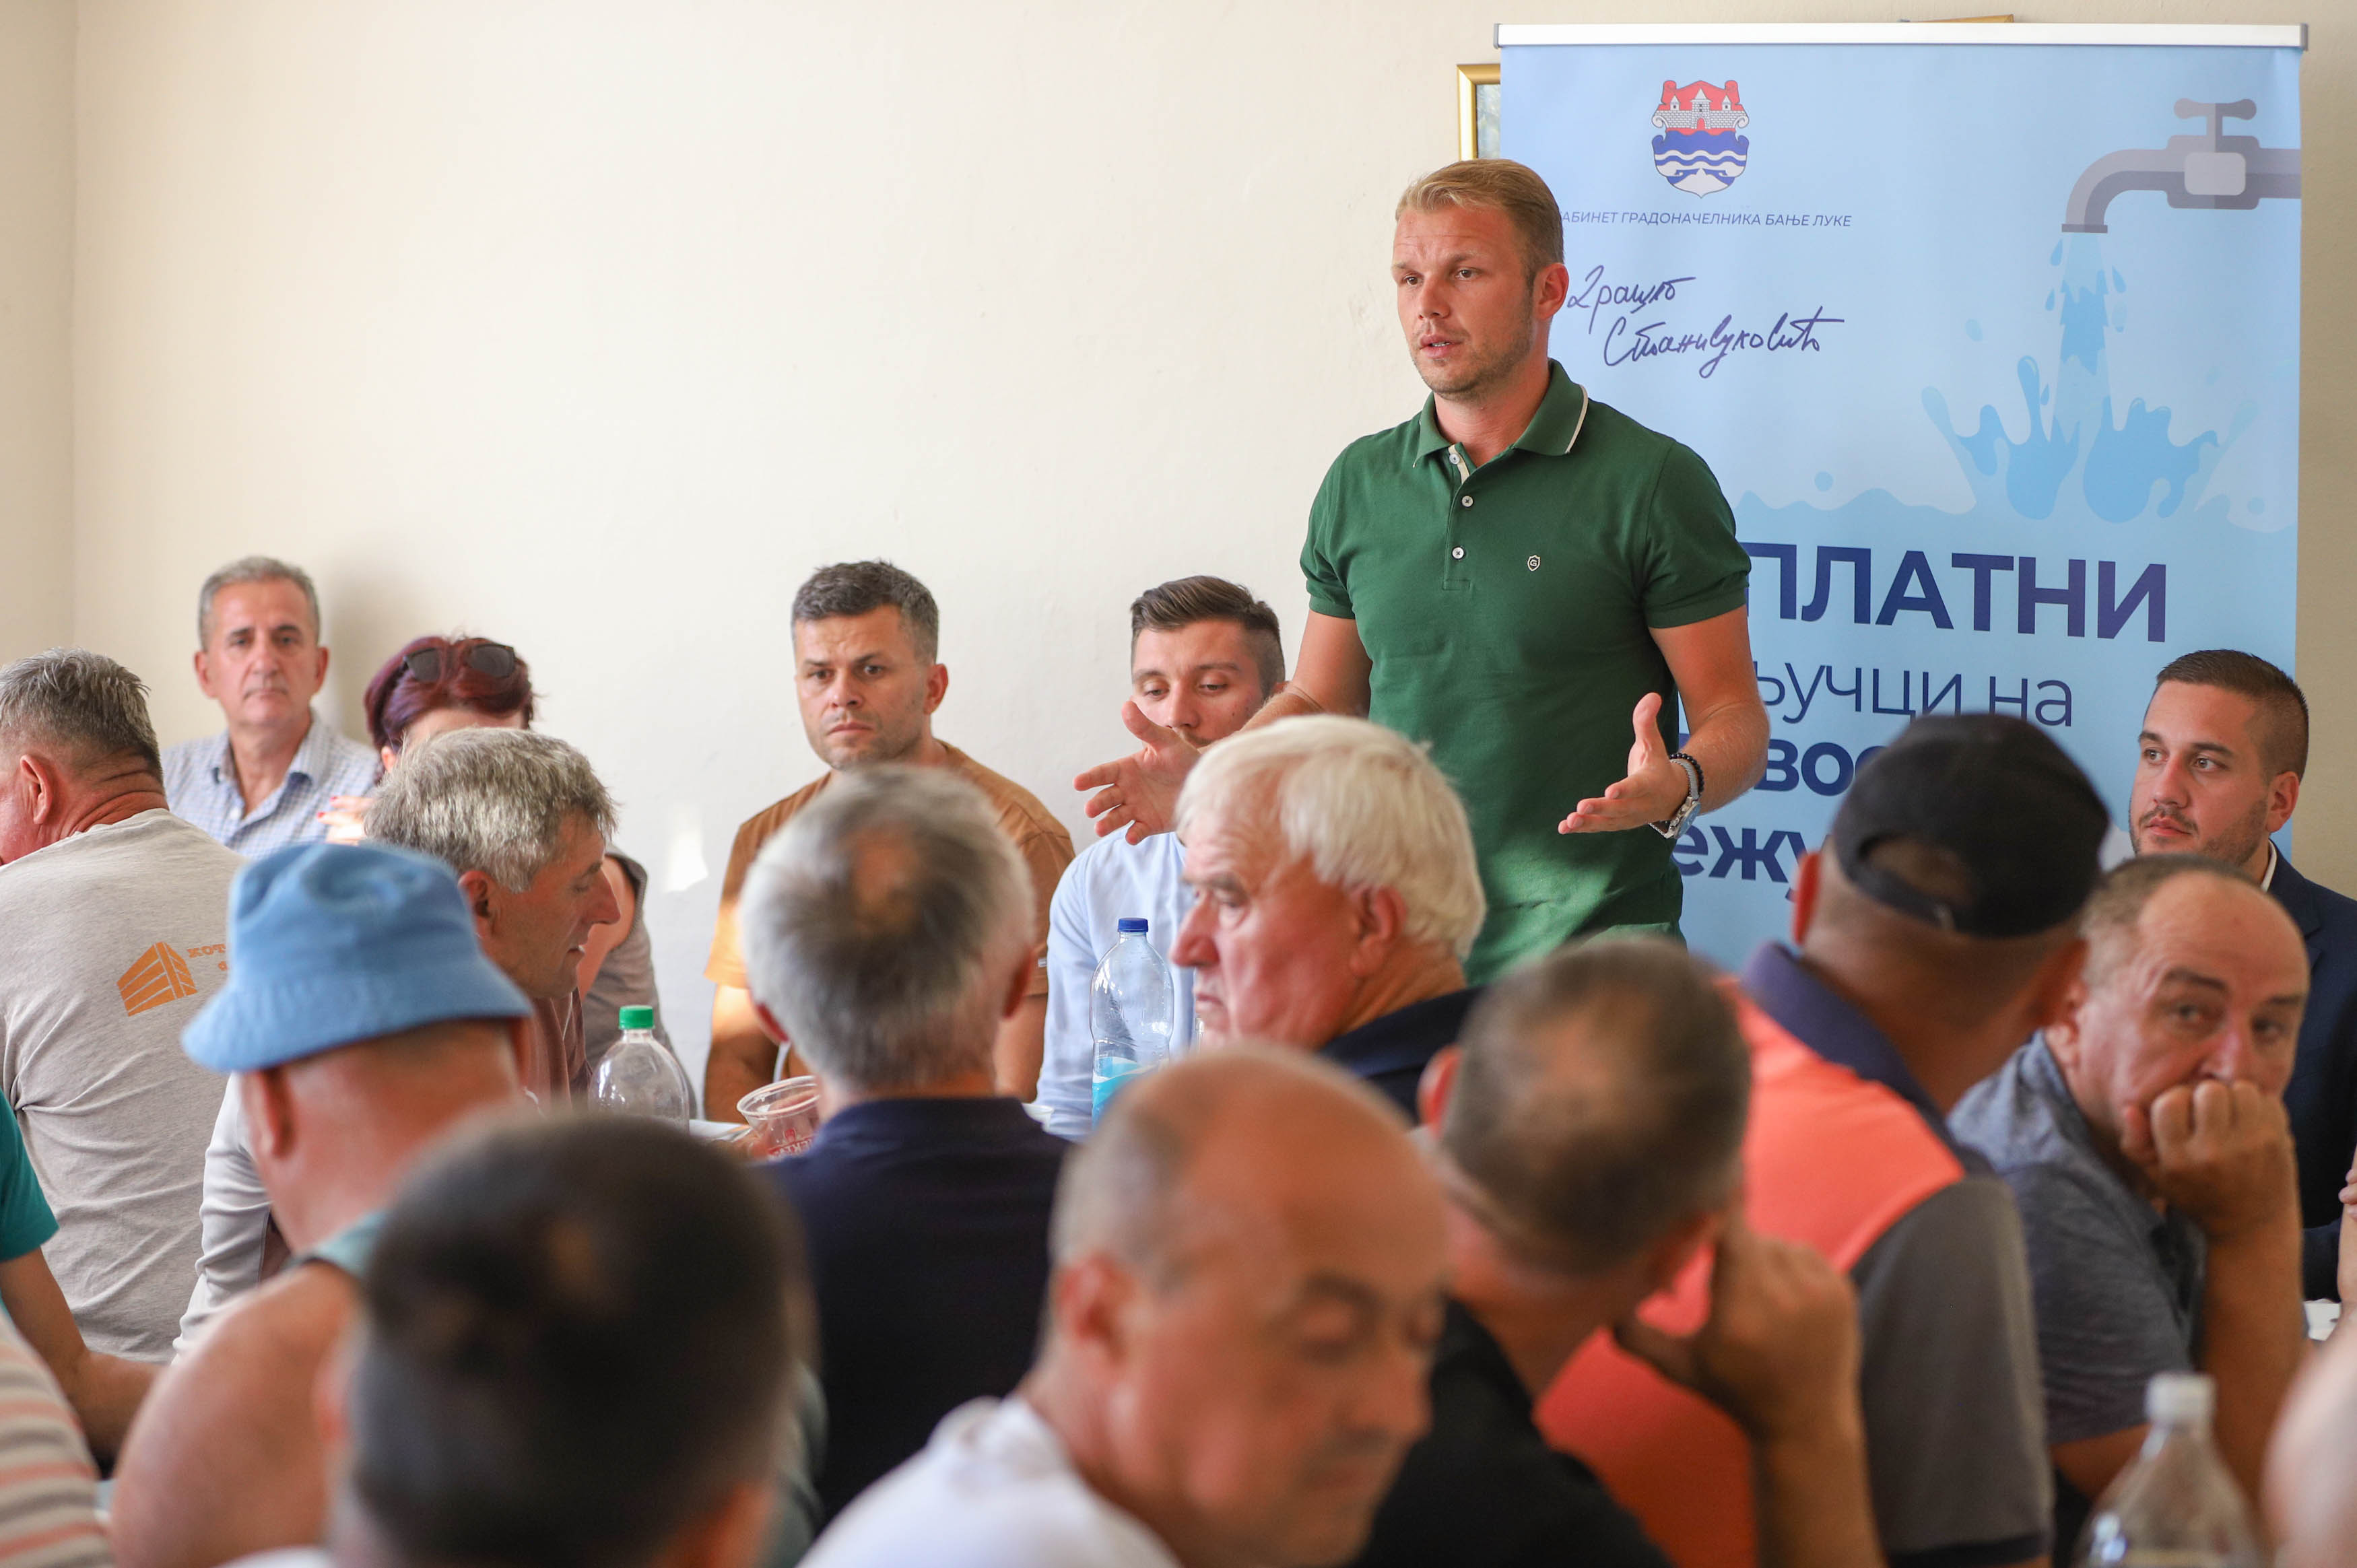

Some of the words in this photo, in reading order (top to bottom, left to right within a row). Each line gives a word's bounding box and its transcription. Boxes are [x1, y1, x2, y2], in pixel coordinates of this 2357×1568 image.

[1561, 211, 1618, 224] АБИНЕТ
[1622, 212, 1761, 225] ГРАДОНАЧЕЛНИКА
[1765, 213, 1810, 226] БАЊЕ
[1812, 215, 1852, 227] ЛУКЕ
[1740, 541, 2166, 643] ПЛАТНИ
